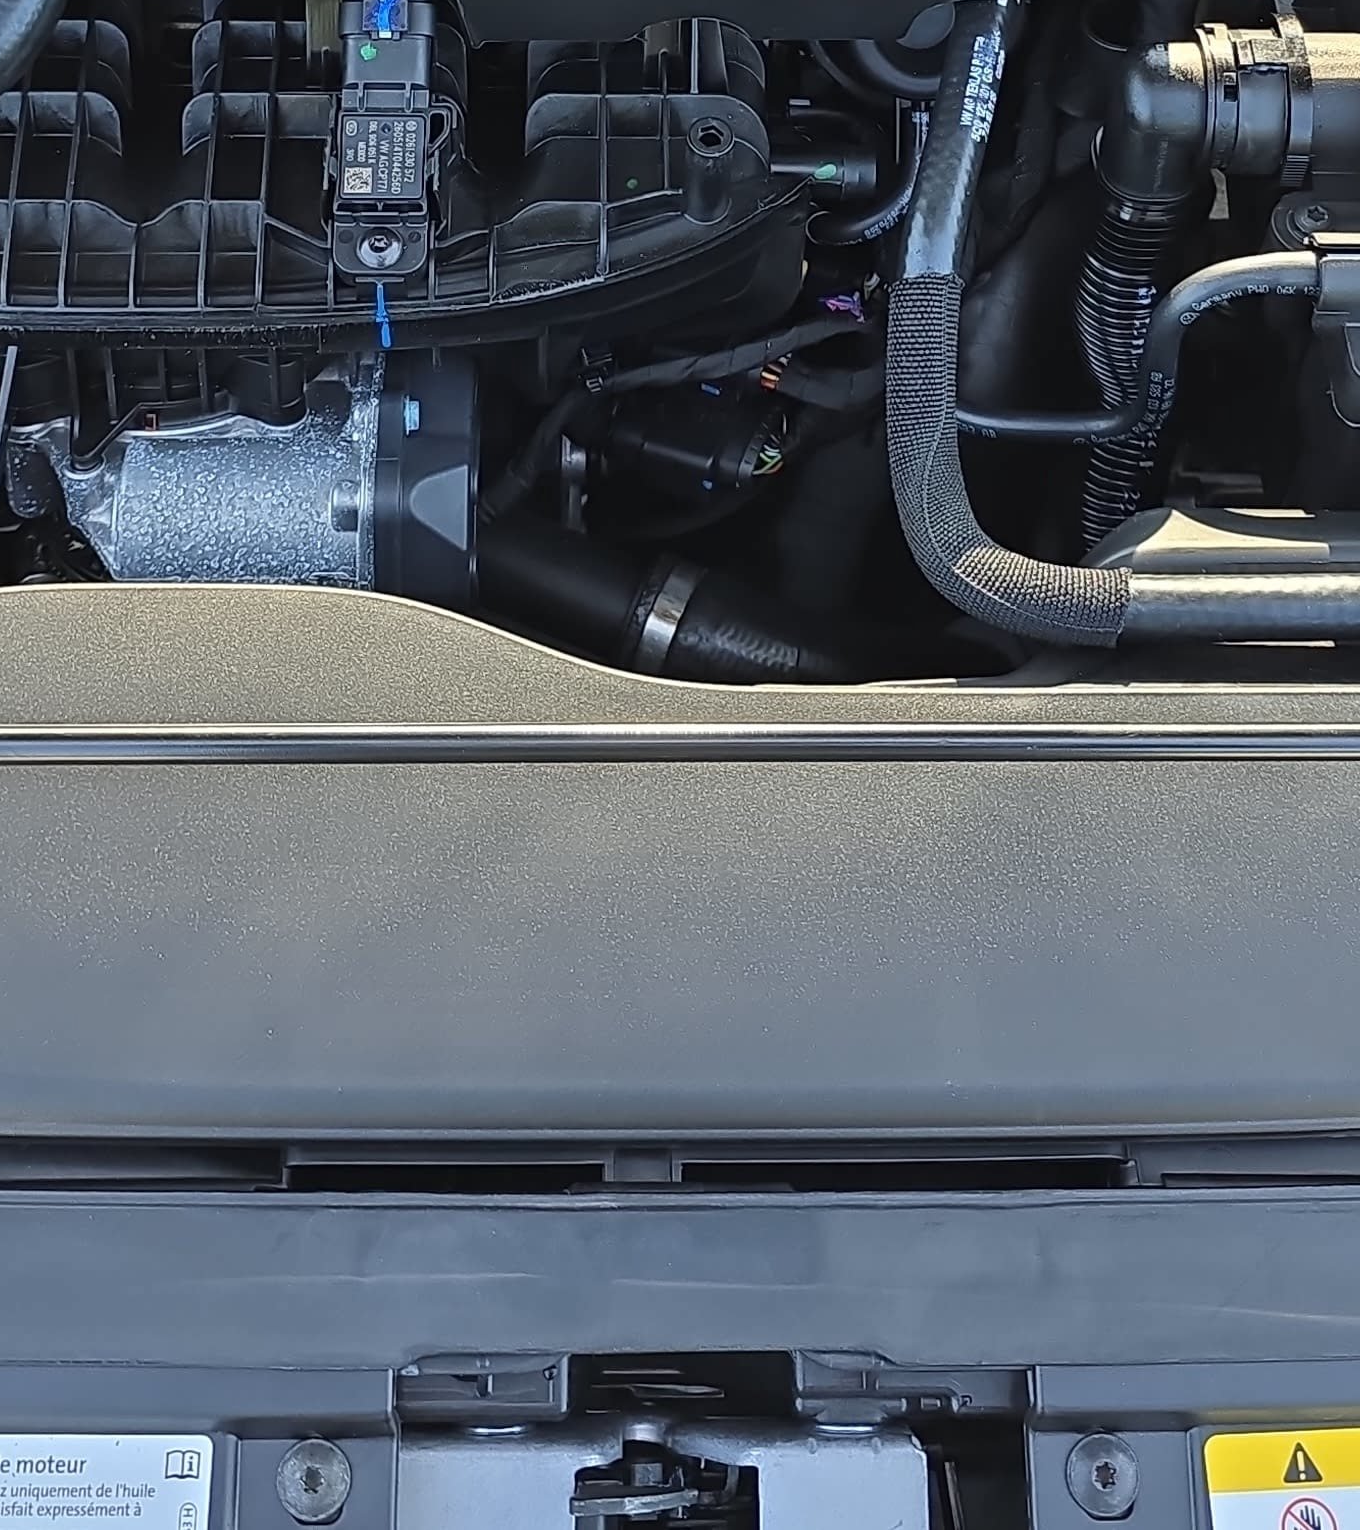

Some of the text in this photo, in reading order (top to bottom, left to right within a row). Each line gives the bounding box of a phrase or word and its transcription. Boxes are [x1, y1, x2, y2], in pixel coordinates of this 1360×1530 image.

[379, 140, 389, 153] VW
[378, 155, 388, 167] AG
[16, 1455, 87, 1474] moteur
[10, 1484, 92, 1504] uniquement
[96, 1484, 113, 1498] de
[116, 1484, 156, 1498] l'huile
[36, 1502, 129, 1520] expressément
[129, 1502, 142, 1517] à
